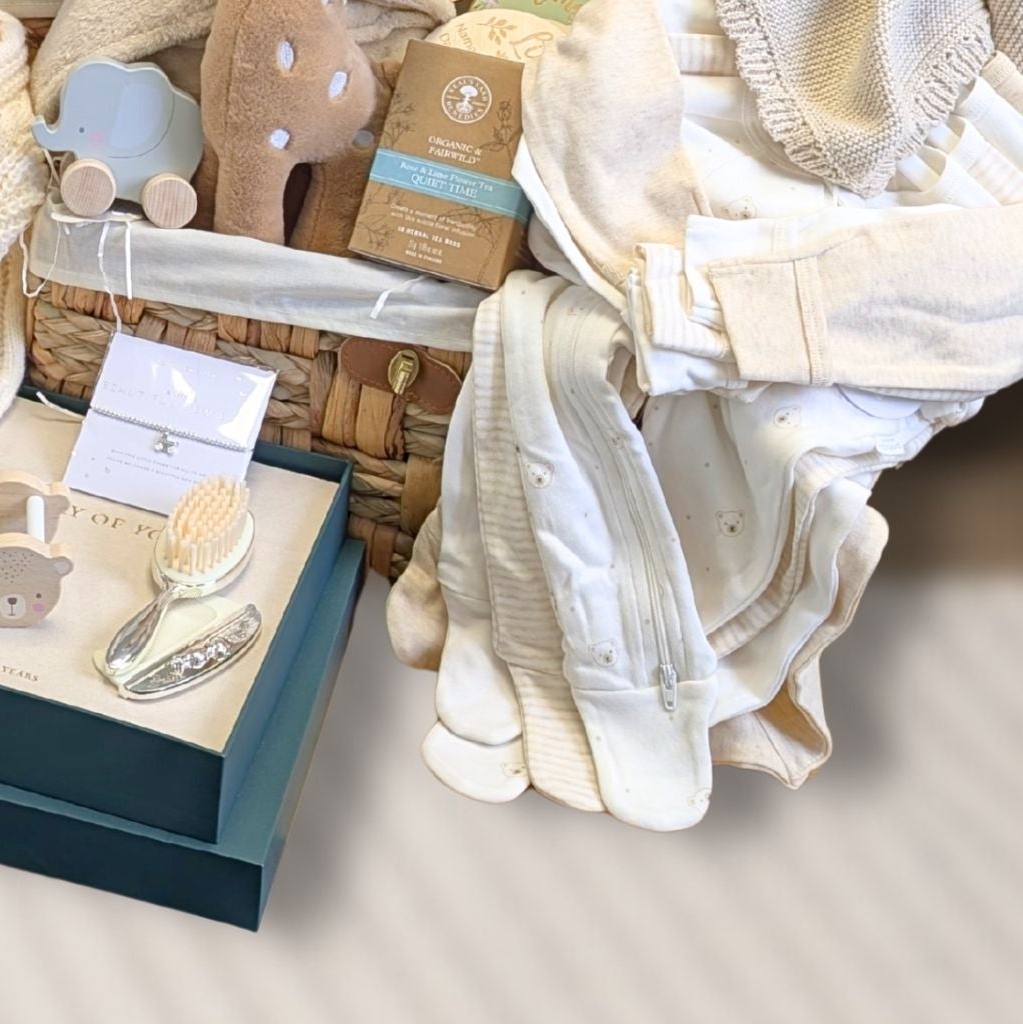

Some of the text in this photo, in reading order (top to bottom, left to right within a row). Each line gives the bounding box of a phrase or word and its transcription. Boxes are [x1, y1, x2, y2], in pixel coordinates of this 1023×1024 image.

[428, 135, 474, 153] ORGANIC
[411, 173, 477, 198] QUIET TIME
[90, 512, 127, 529] OF
[2, 665, 39, 682] YEARS
